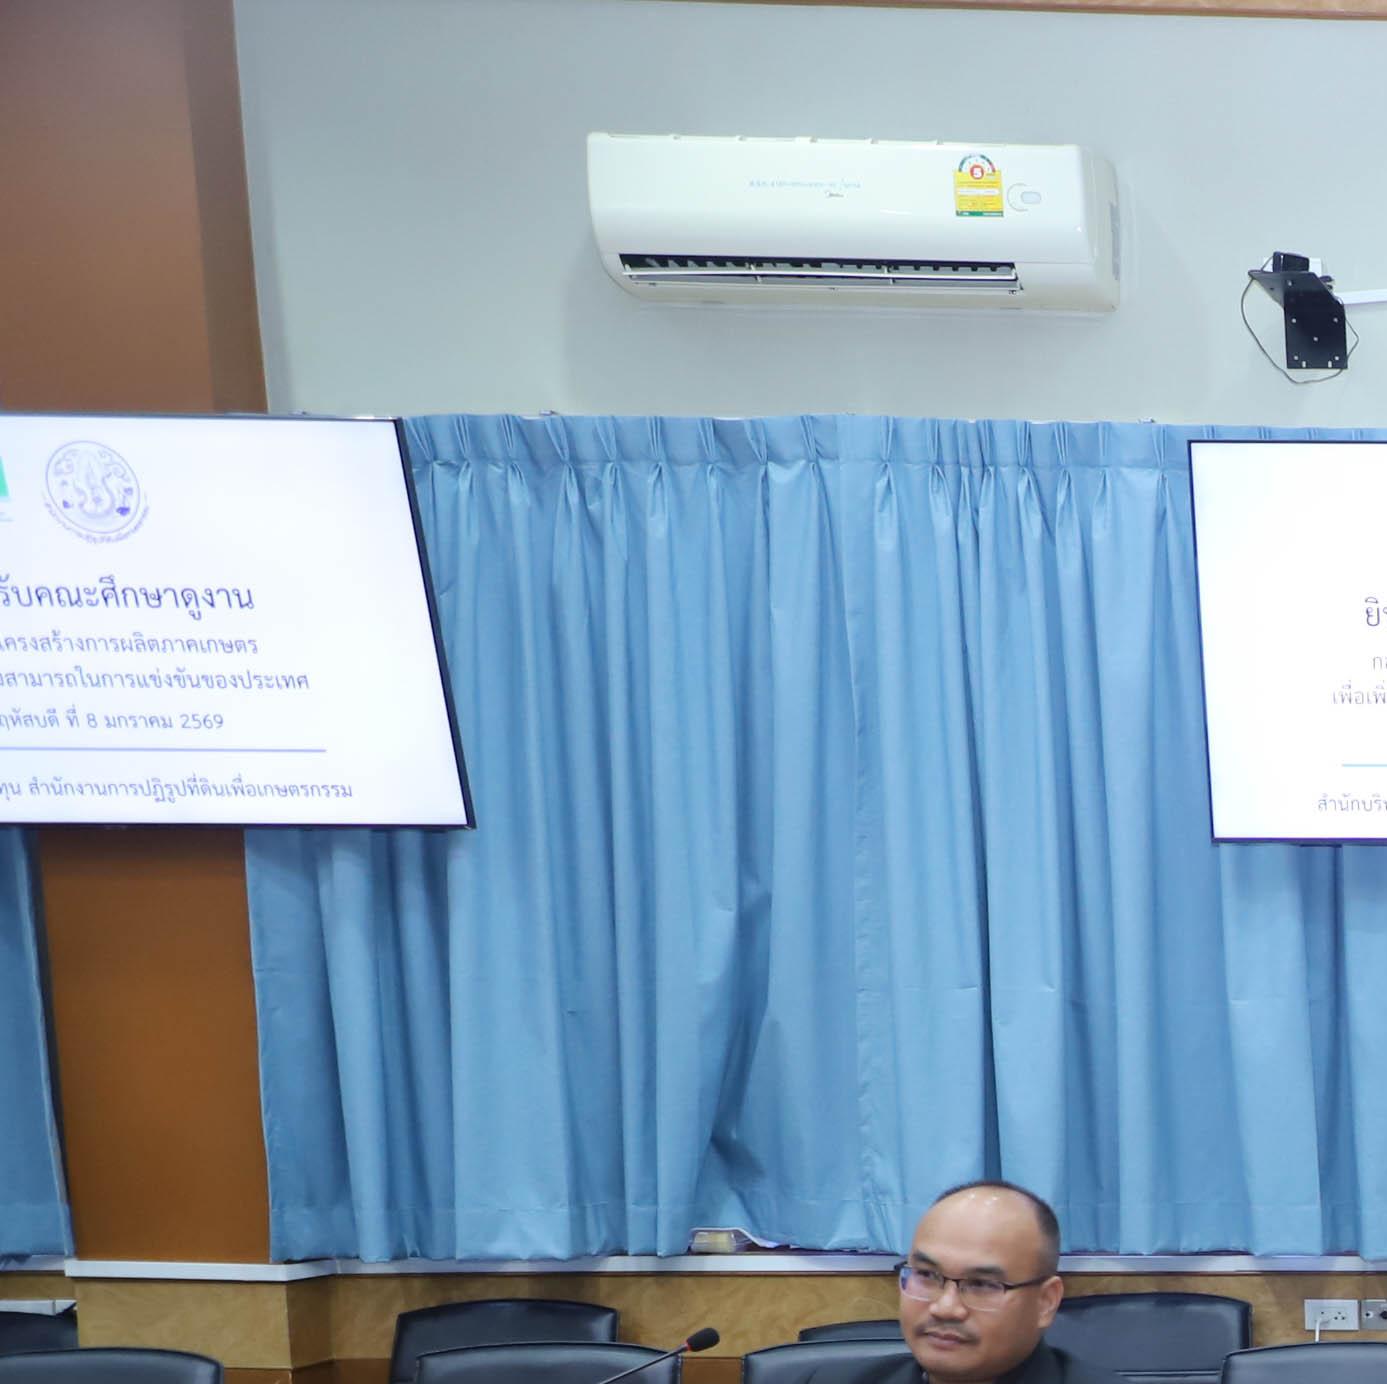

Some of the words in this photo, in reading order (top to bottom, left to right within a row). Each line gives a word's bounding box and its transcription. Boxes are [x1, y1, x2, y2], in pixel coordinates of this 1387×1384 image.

[0, 629, 258, 654] ครงสร้างการผลิตภาคเกษตร
[65, 704, 80, 728] ที่
[86, 713, 98, 728] 8
[104, 715, 174, 729] มกราคม
[179, 713, 224, 730] 2569
